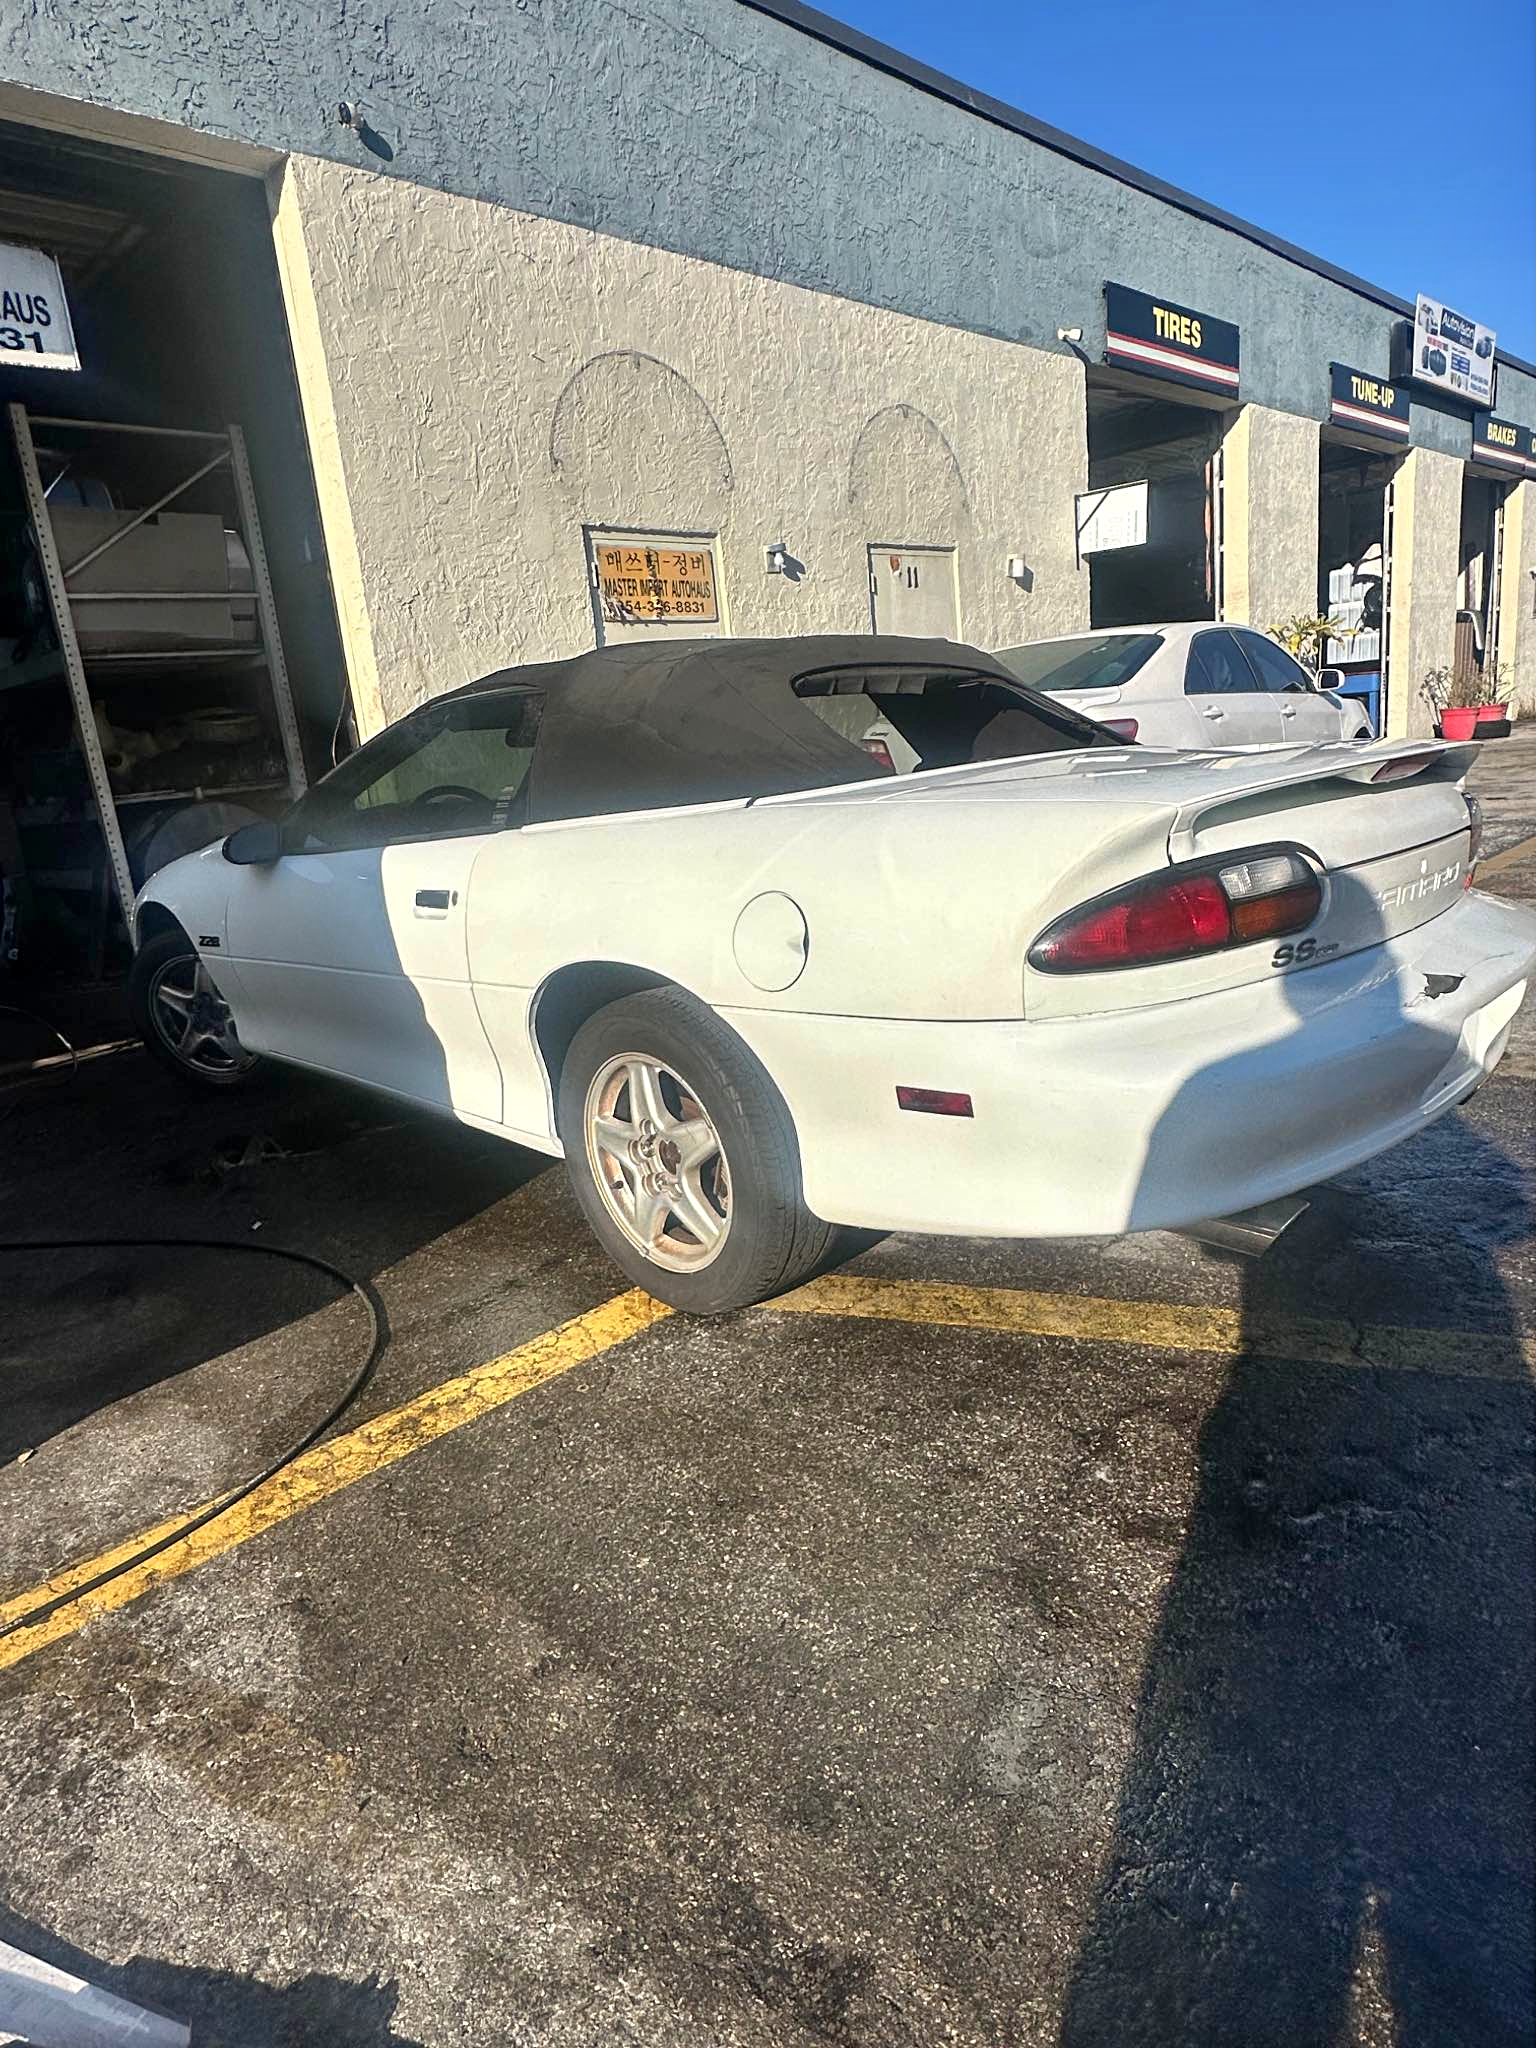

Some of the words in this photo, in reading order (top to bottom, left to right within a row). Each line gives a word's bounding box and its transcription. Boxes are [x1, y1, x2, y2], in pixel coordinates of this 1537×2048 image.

[0, 291, 51, 327] AUS
[1152, 306, 1202, 349] TIRES
[1351, 375, 1395, 409] TUNE-UP
[1487, 422, 1517, 447] BRAKES
[604, 577, 640, 597] MASTER
[640, 579, 668, 597] IMPRT
[671, 580, 711, 599] AUTOHAUS
[907, 566, 919, 588] 11
[1271, 938, 1317, 968] SS
